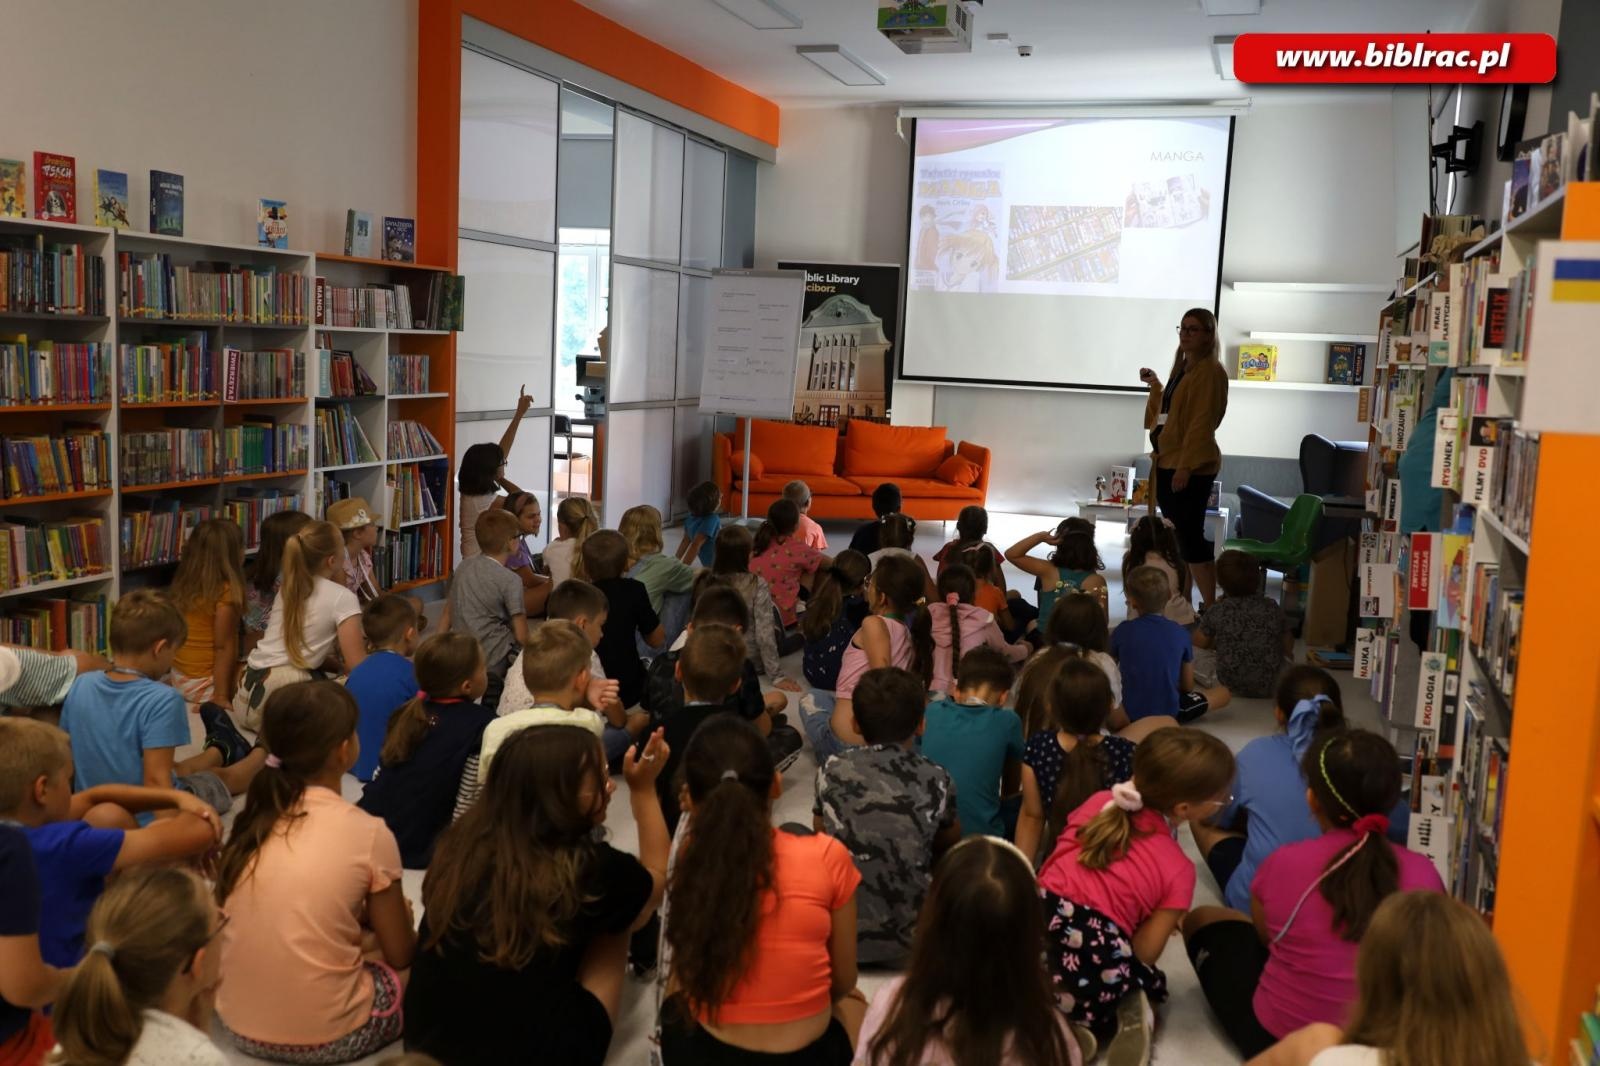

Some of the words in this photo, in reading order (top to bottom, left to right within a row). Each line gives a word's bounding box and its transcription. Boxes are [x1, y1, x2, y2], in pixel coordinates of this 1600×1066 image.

[1150, 151, 1204, 162] MANGA
[806, 273, 825, 282] blic
[826, 273, 860, 286] Library
[806, 283, 836, 292] ciborz
[1488, 292, 1508, 344] NETFLIX
[1396, 408, 1406, 450] DINOZAURY
[1442, 440, 1453, 486] RYSUNEK
[1477, 448, 1488, 469] DVD
[1475, 471, 1486, 501] FILMY
[1411, 550, 1420, 588] ZWYCZAJE
[1360, 647, 1370, 677] NAUKA
[1423, 675, 1436, 726] EKOLOGIA
